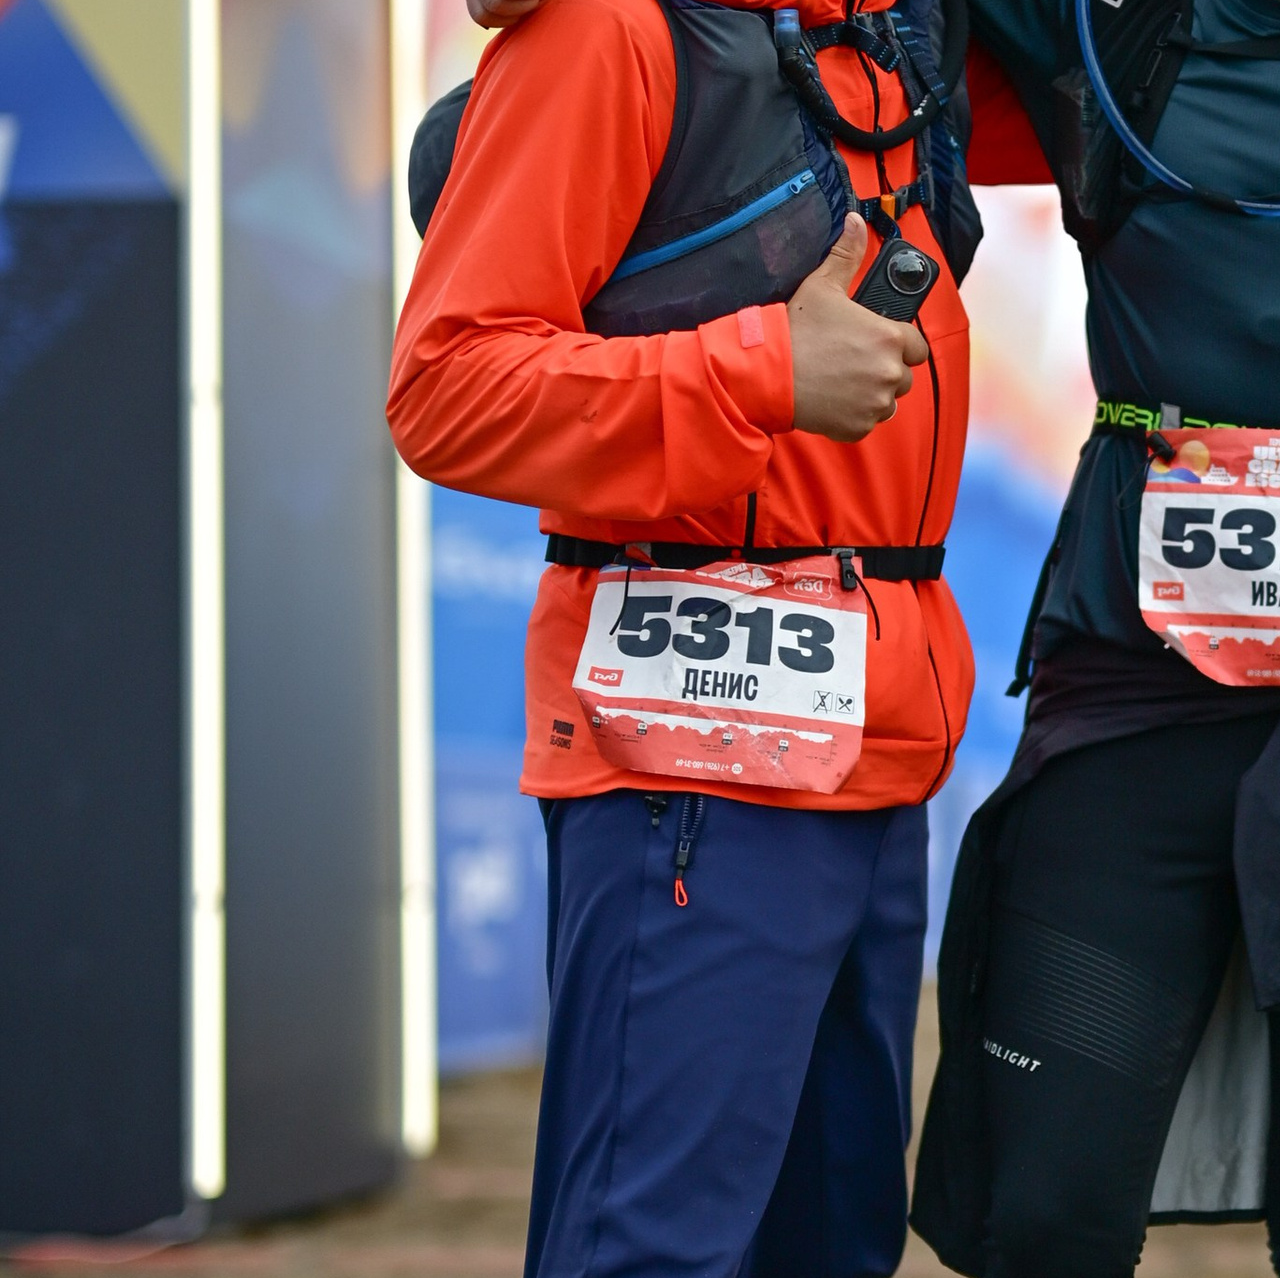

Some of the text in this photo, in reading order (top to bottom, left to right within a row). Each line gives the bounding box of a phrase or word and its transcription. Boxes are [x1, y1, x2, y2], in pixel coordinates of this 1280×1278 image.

[616, 595, 835, 674] 5313
[681, 667, 759, 702] ДЕНИС
[983, 1037, 1042, 1072] AIDLIGHT
